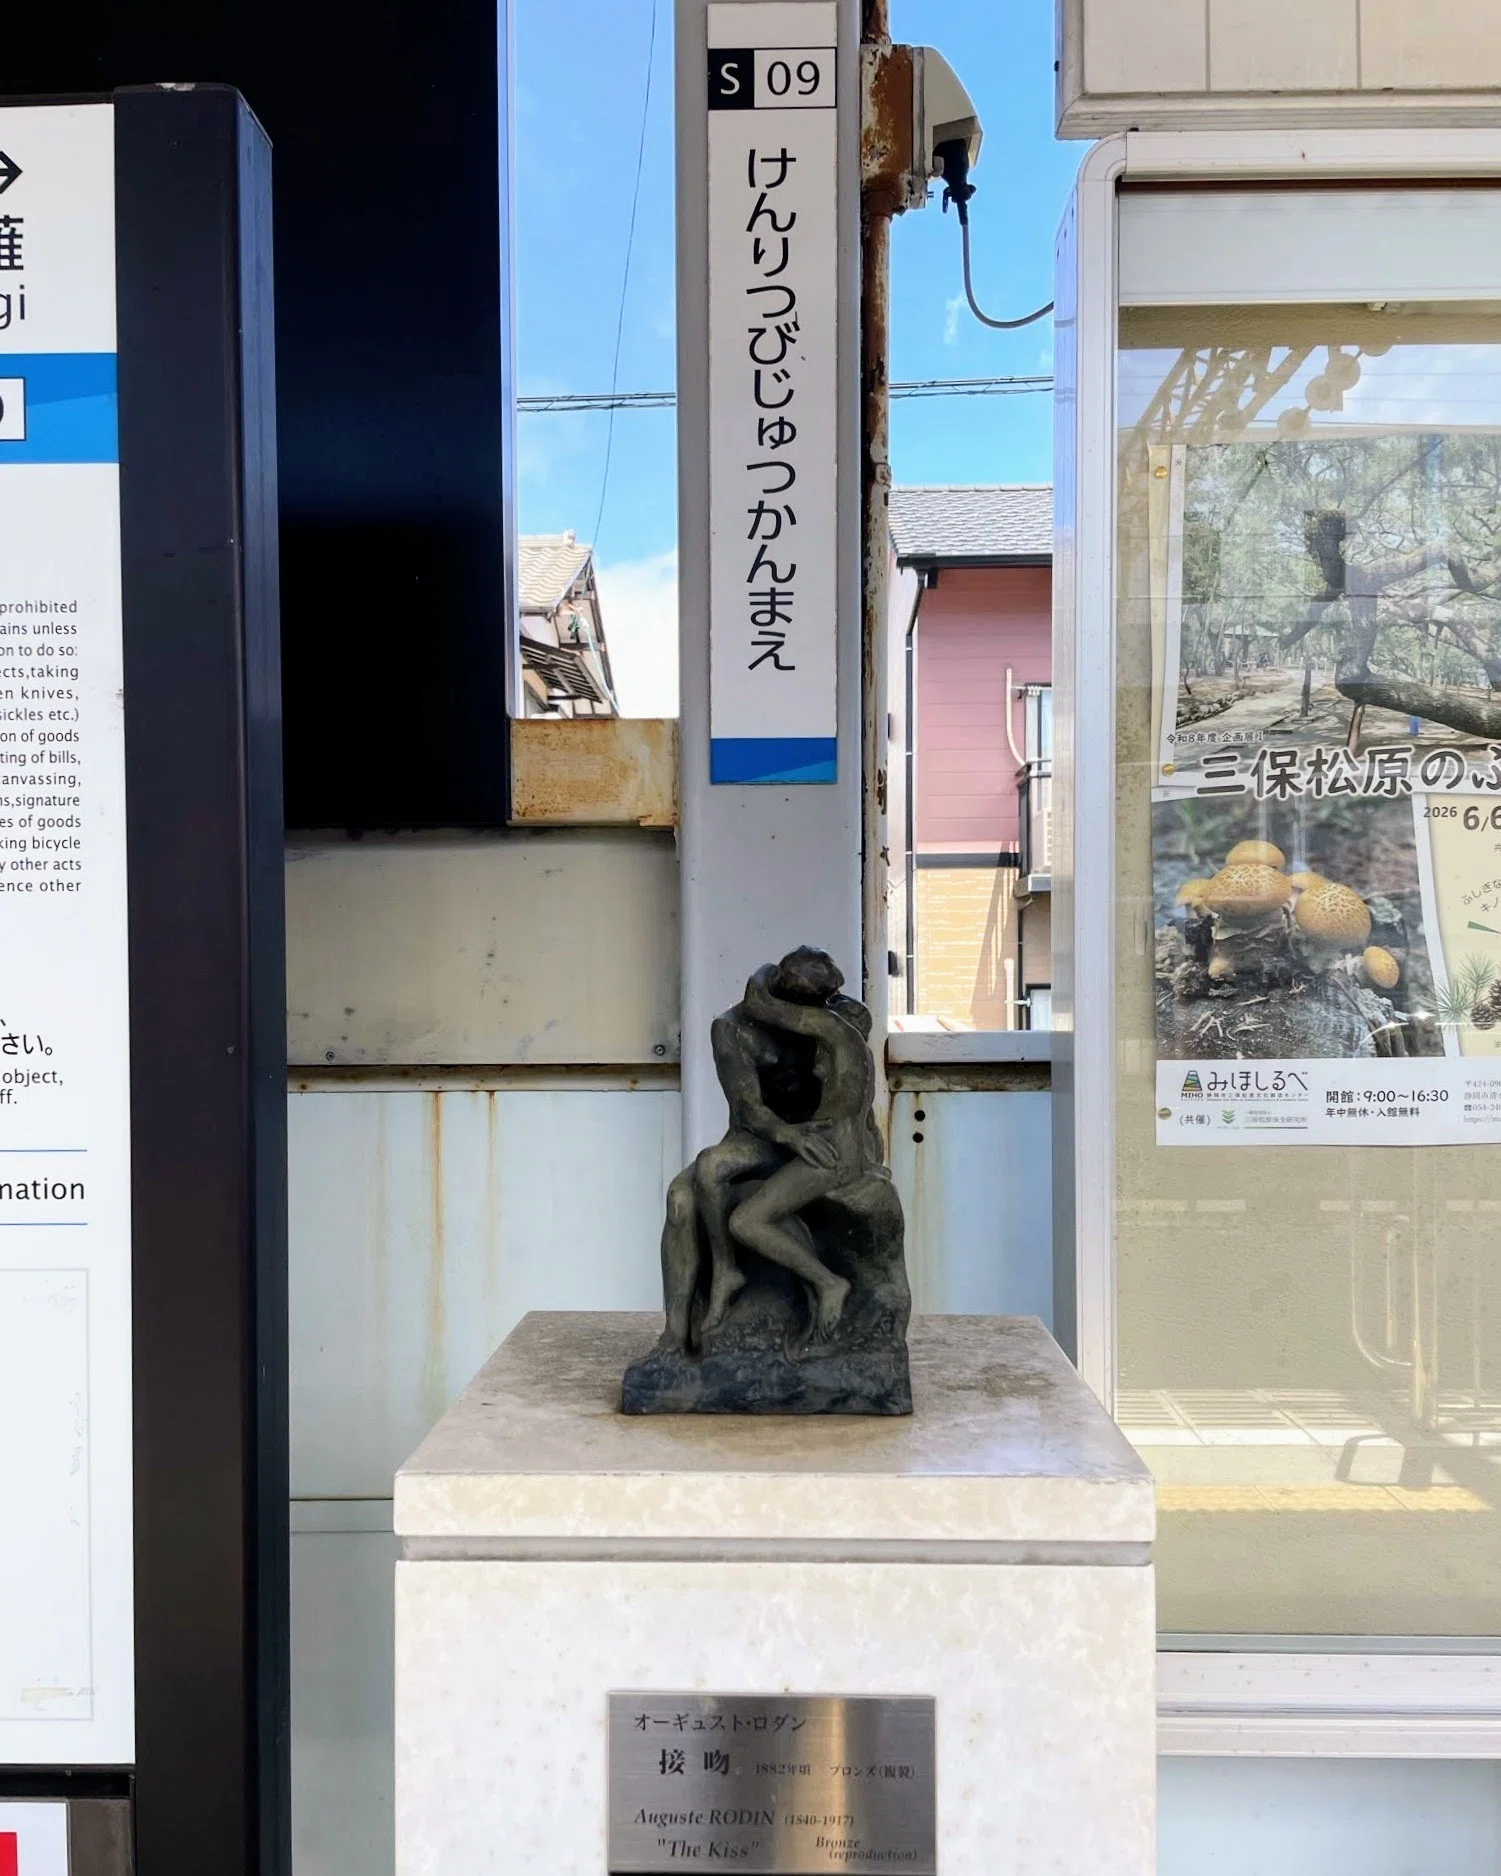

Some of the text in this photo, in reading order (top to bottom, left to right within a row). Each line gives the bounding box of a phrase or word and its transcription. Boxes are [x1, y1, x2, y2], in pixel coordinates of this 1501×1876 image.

[720, 60, 821, 96] S 09
[746, 147, 801, 671] けんりつびじゅつかんまえ
[33, 622, 78, 635] unless
[19, 645, 33, 656] to
[37, 643, 54, 656] do
[58, 646, 78, 656] so:
[21, 686, 79, 701] knives,
[48, 707, 79, 722] etc.)
[21, 729, 34, 742] of
[38, 729, 80, 745] goods
[31, 750, 45, 764] of
[49, 750, 81, 765] bills,
[1423, 806, 1457, 818] 2026
[19, 814, 33, 828] of
[37, 814, 82, 831] goods
[32, 836, 81, 852] bicycle
[10, 857, 48, 870] other
[53, 859, 82, 870] acts
[39, 879, 82, 892] other
[2, 1068, 63, 1087] object,
[1207, 1070, 1308, 1091] みほしるべ
[634, 1808, 704, 1828] Auguste
[709, 1808, 775, 1825] RODIN
[816, 1836, 860, 1849] Bronze
[829, 1849, 918, 1862] (reproduction)
